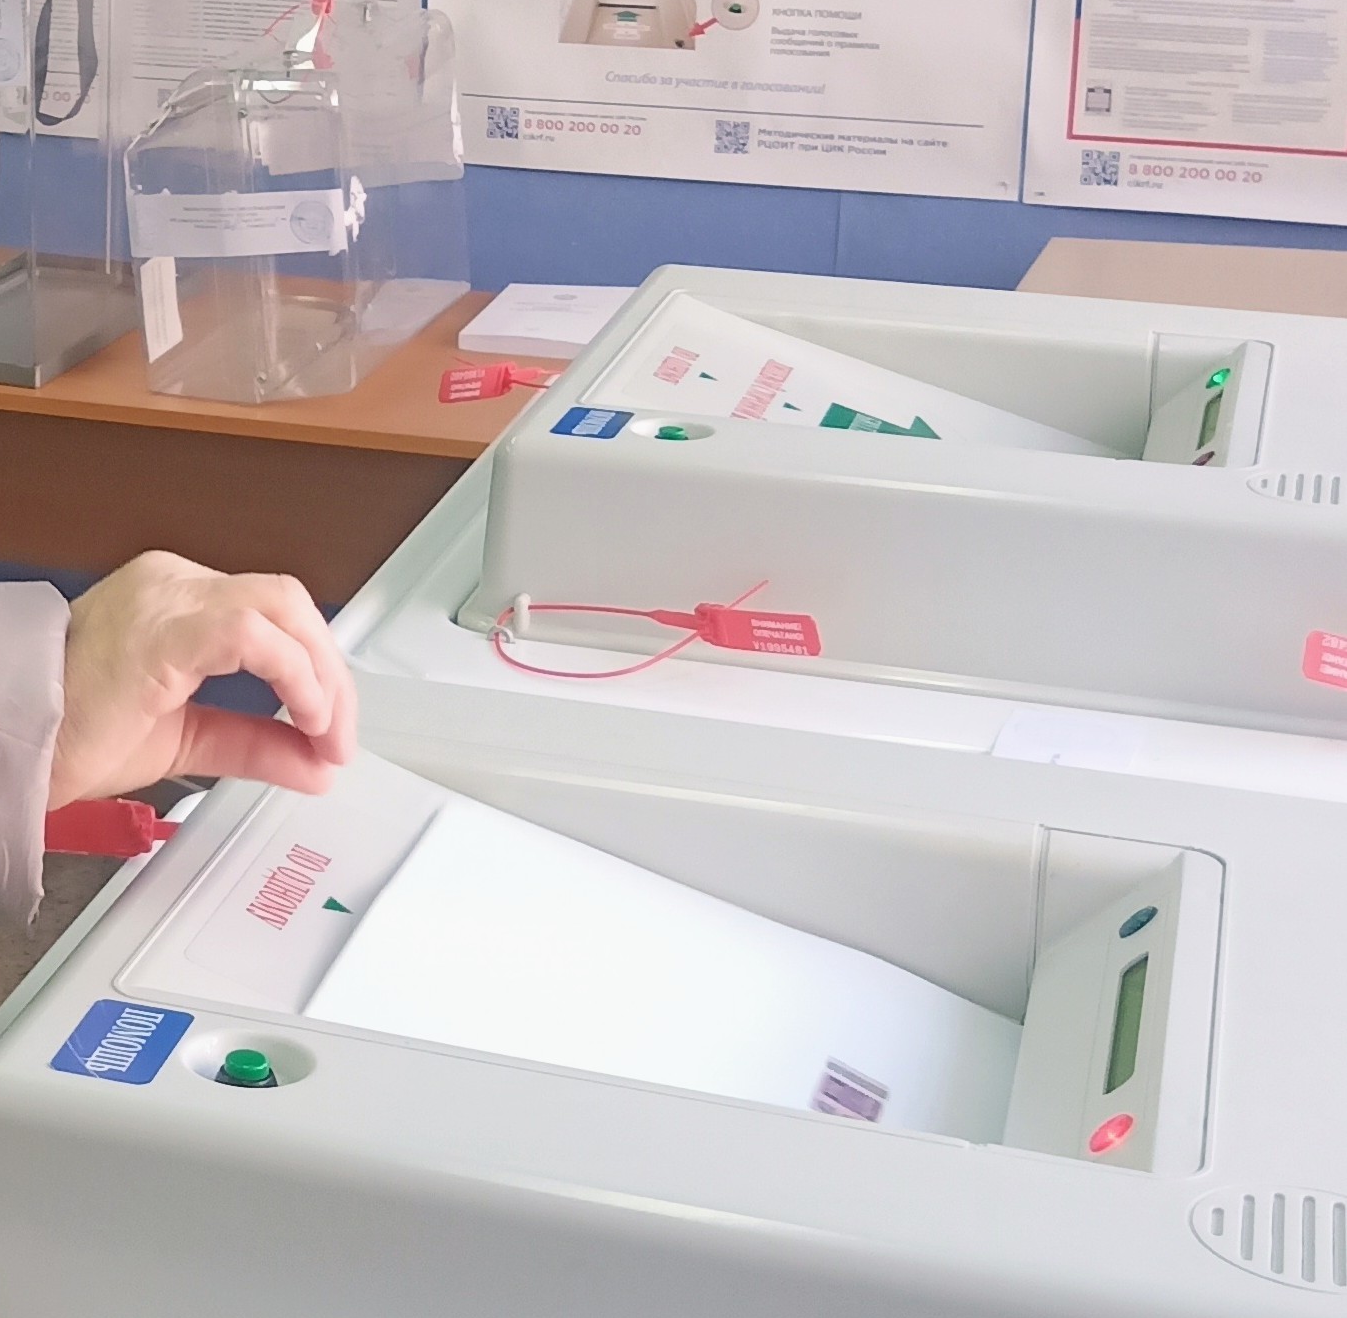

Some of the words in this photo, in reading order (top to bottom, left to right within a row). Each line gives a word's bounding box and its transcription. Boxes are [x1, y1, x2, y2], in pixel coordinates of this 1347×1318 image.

[524, 119, 532, 129] 8
[536, 119, 564, 131] 800
[568, 120, 595, 133] 200
[600, 122, 620, 134] 00
[623, 124, 642, 136] 20
[1128, 163, 1138, 174] 8
[1142, 164, 1174, 177] 800
[1178, 166, 1210, 180] 200
[1215, 169, 1236, 181] 00
[1242, 170, 1262, 183] 20
[286, 843, 332, 872] ПО
[246, 866, 315, 930] ОДНОМУ
[88, 1008, 165, 1073] ПОМОЩЬ
